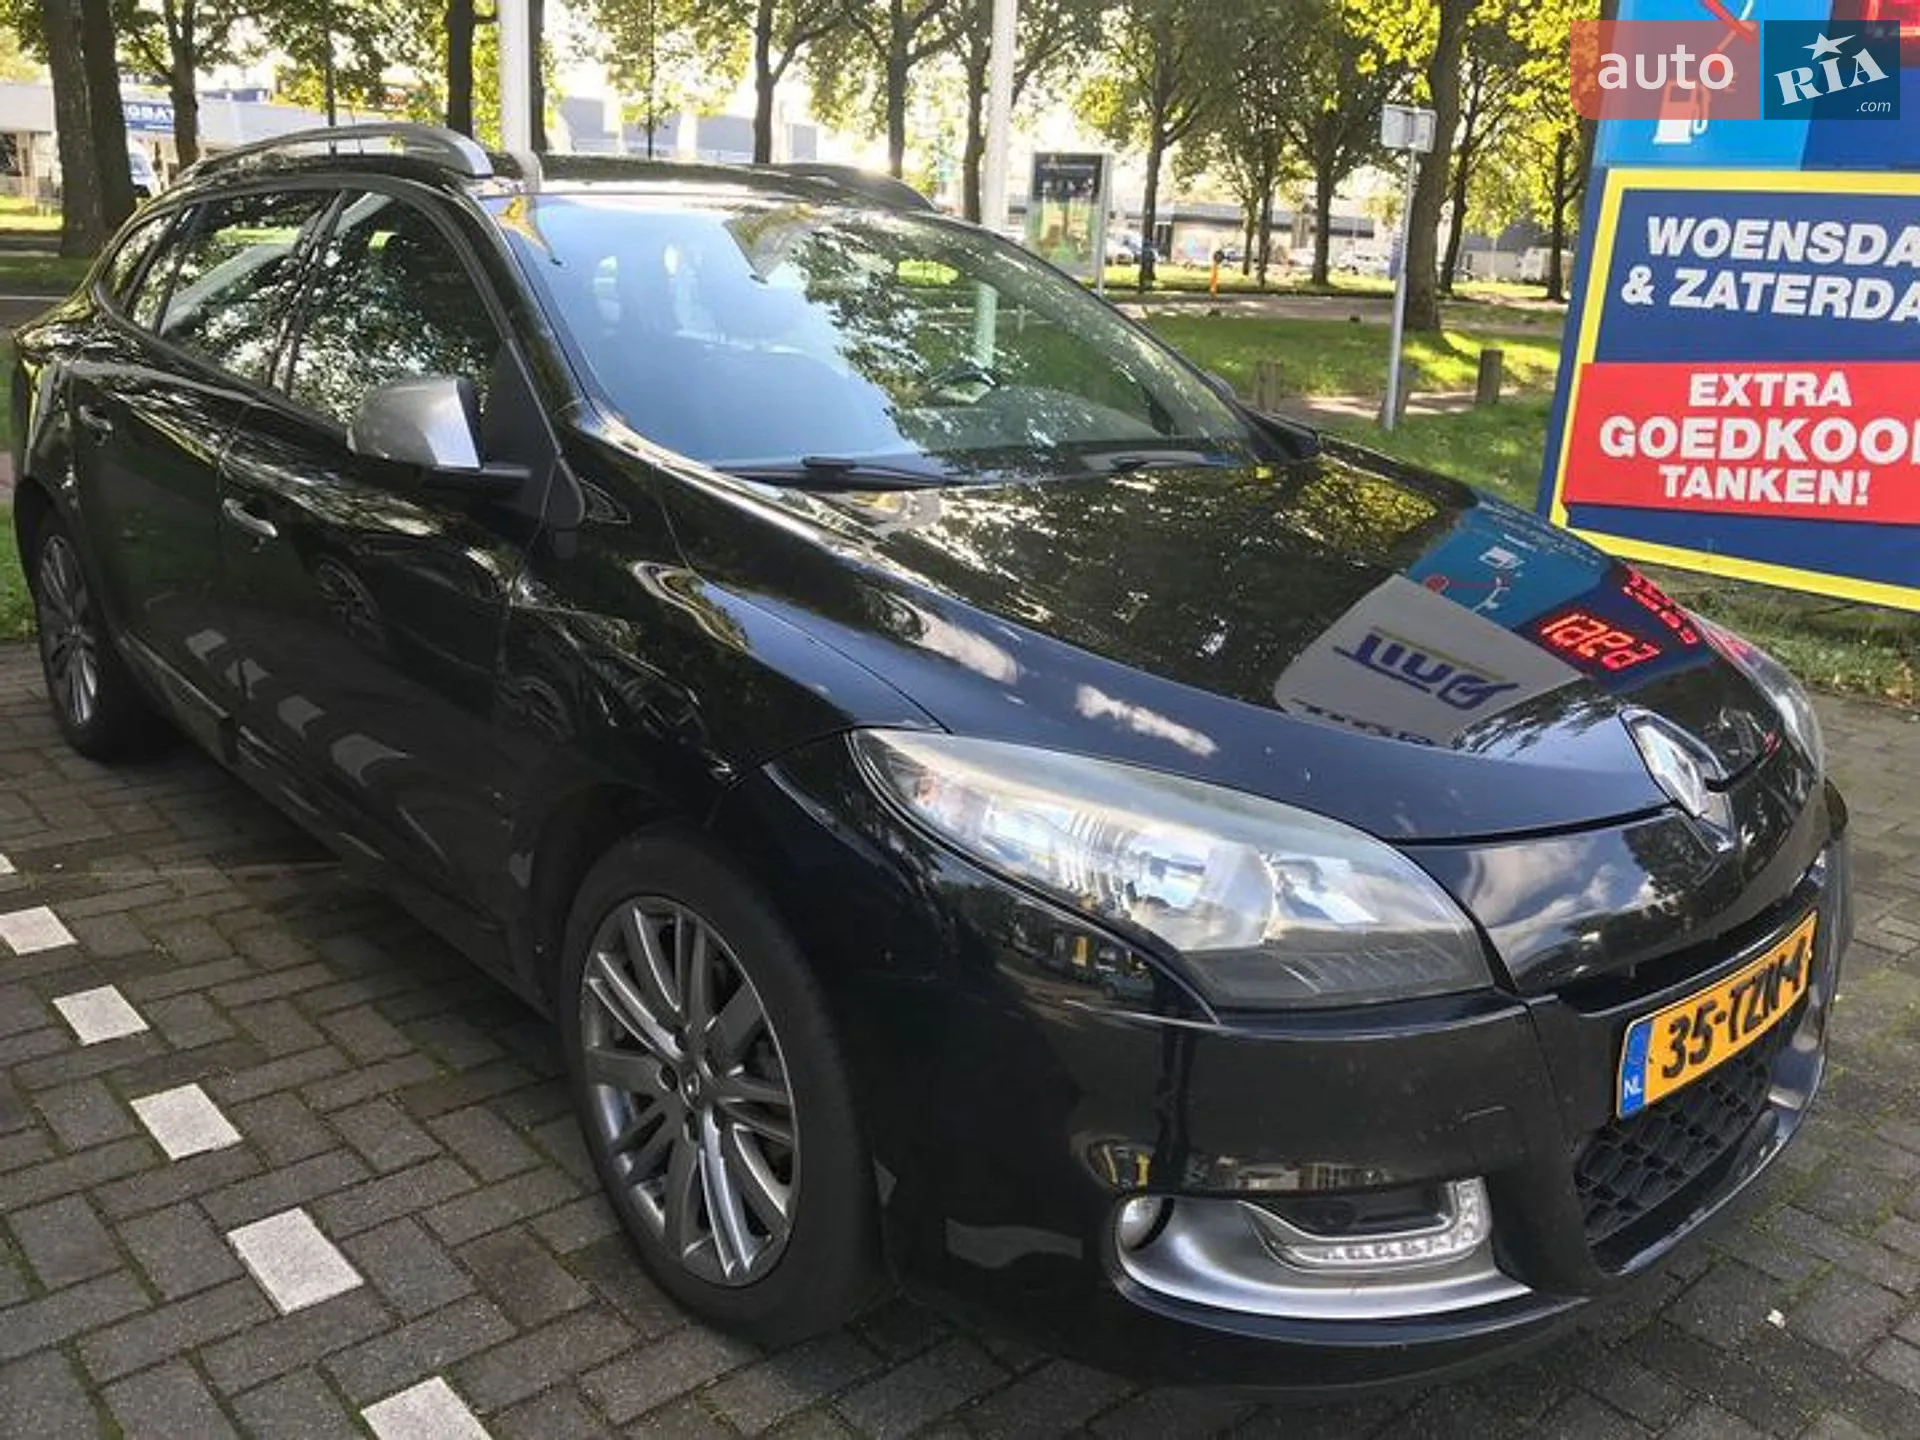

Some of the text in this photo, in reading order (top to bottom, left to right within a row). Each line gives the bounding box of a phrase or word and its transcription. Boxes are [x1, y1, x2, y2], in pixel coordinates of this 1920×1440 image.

[1647, 215, 1920, 267] WOENSDA
[1621, 266, 1920, 322] & ZATERDA
[1688, 371, 1852, 408] EXTRA
[1599, 415, 1920, 465] GOEDKOO
[1658, 464, 1871, 505] TANKEN!
[1623, 1077, 1642, 1099] NL
